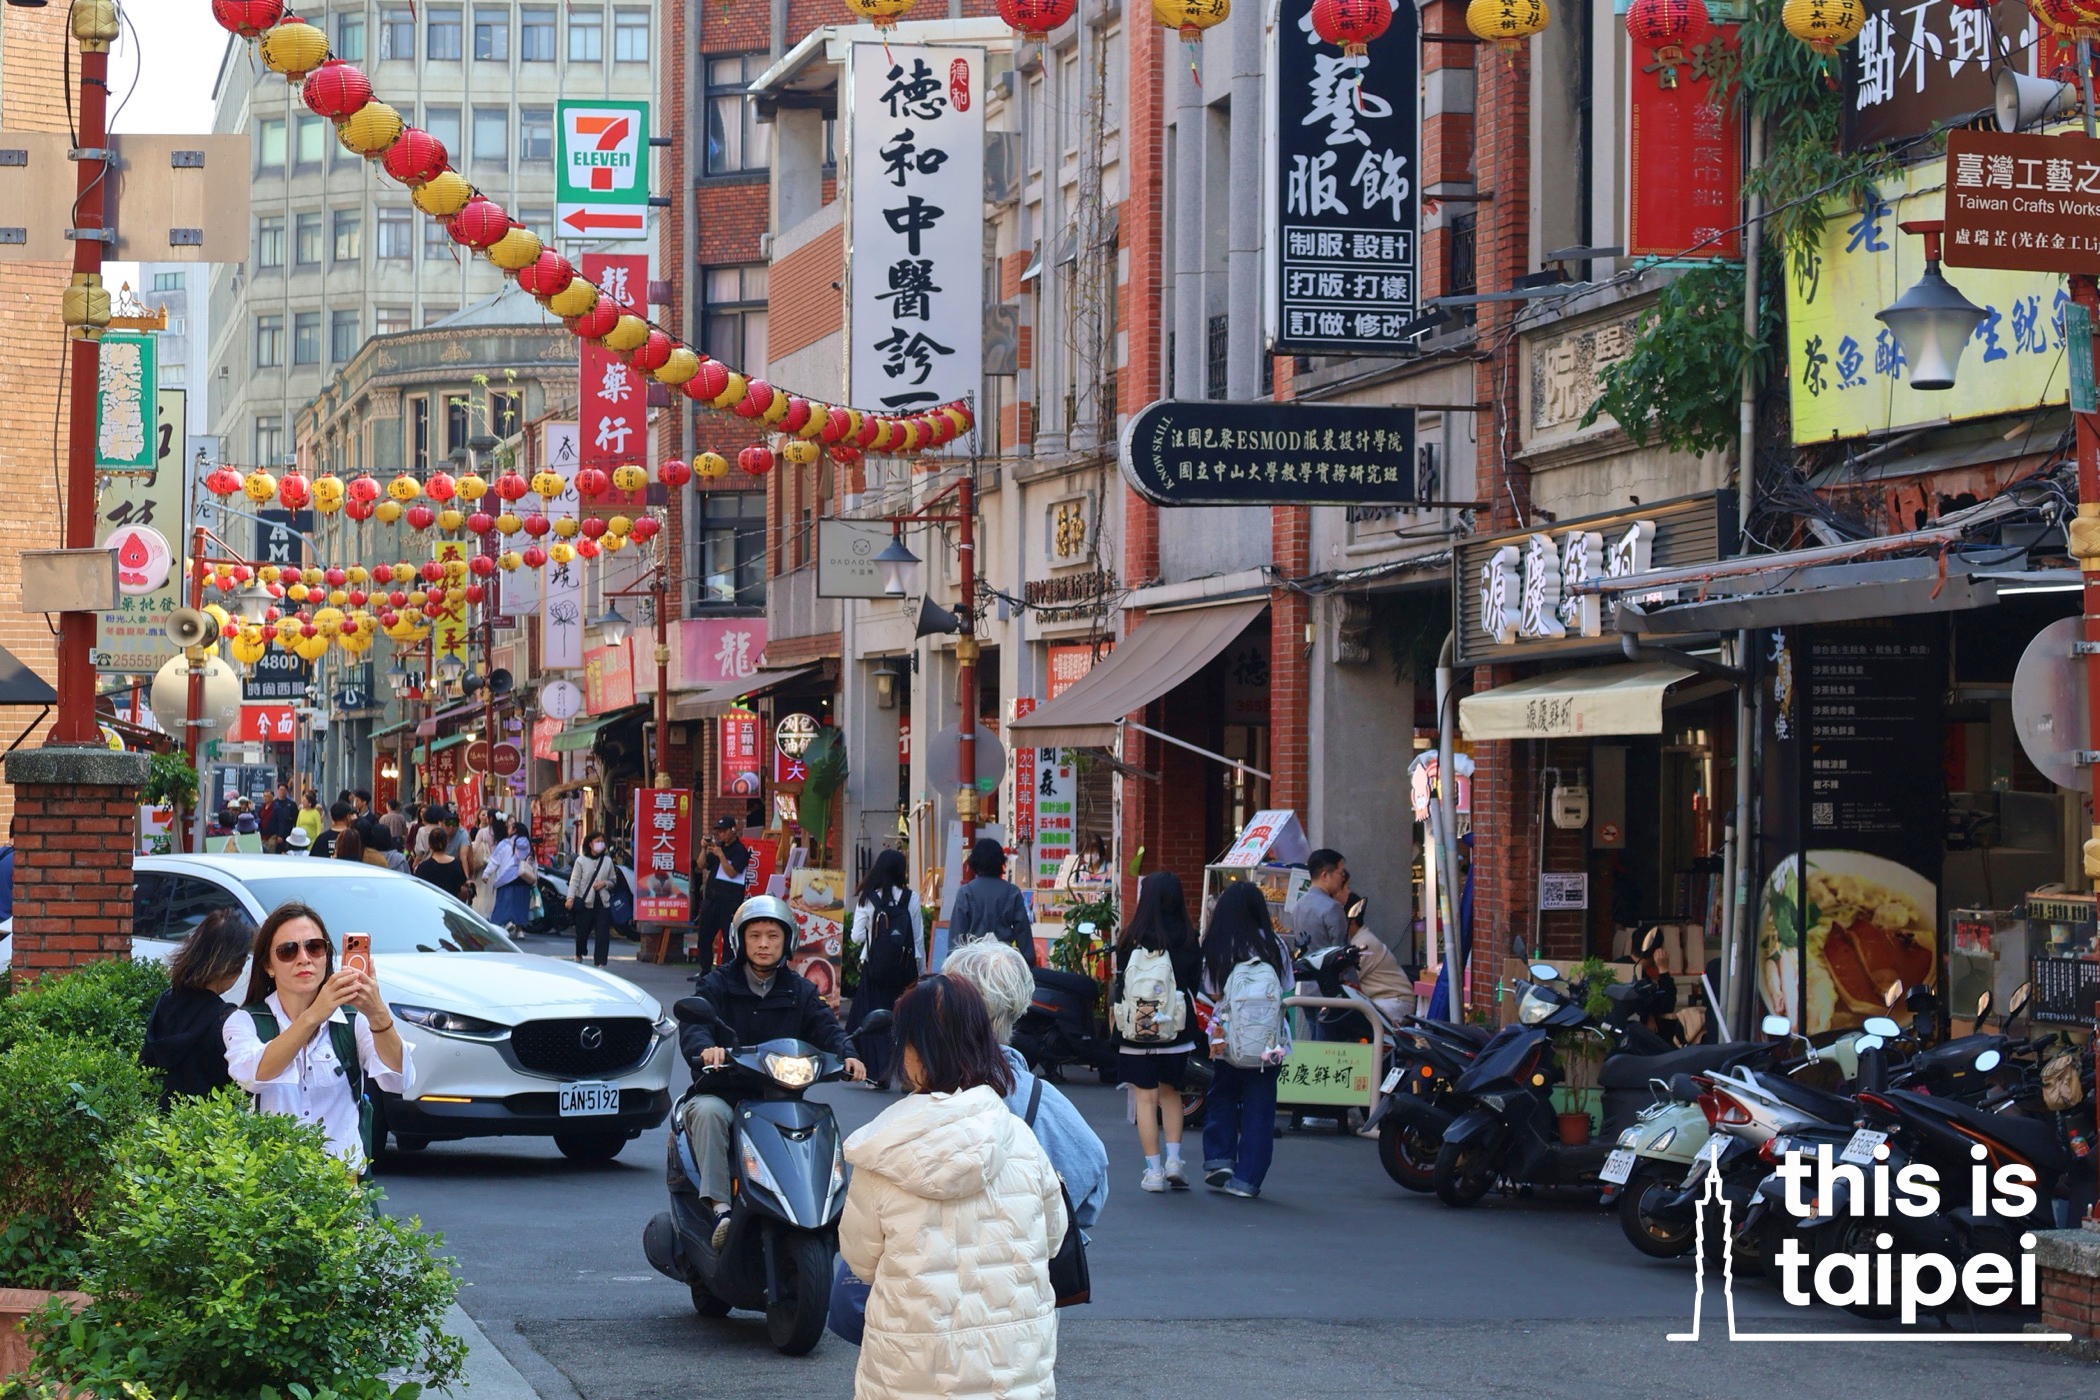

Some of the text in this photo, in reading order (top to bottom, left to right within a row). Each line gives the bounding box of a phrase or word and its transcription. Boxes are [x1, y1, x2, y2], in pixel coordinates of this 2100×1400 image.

[576, 117, 629, 190] 7
[1288, 149, 1409, 222] 服飾
[1957, 194, 2008, 211] Taiwan
[2012, 197, 2055, 214] Crafts
[594, 266, 635, 454] 龍藥行
[1153, 415, 1174, 452] SKILL
[1153, 454, 1176, 491] KNOW
[830, 558, 874, 566] DADAOC
[113, 653, 177, 669] 2555510
[651, 792, 677, 871] 草莓大福
